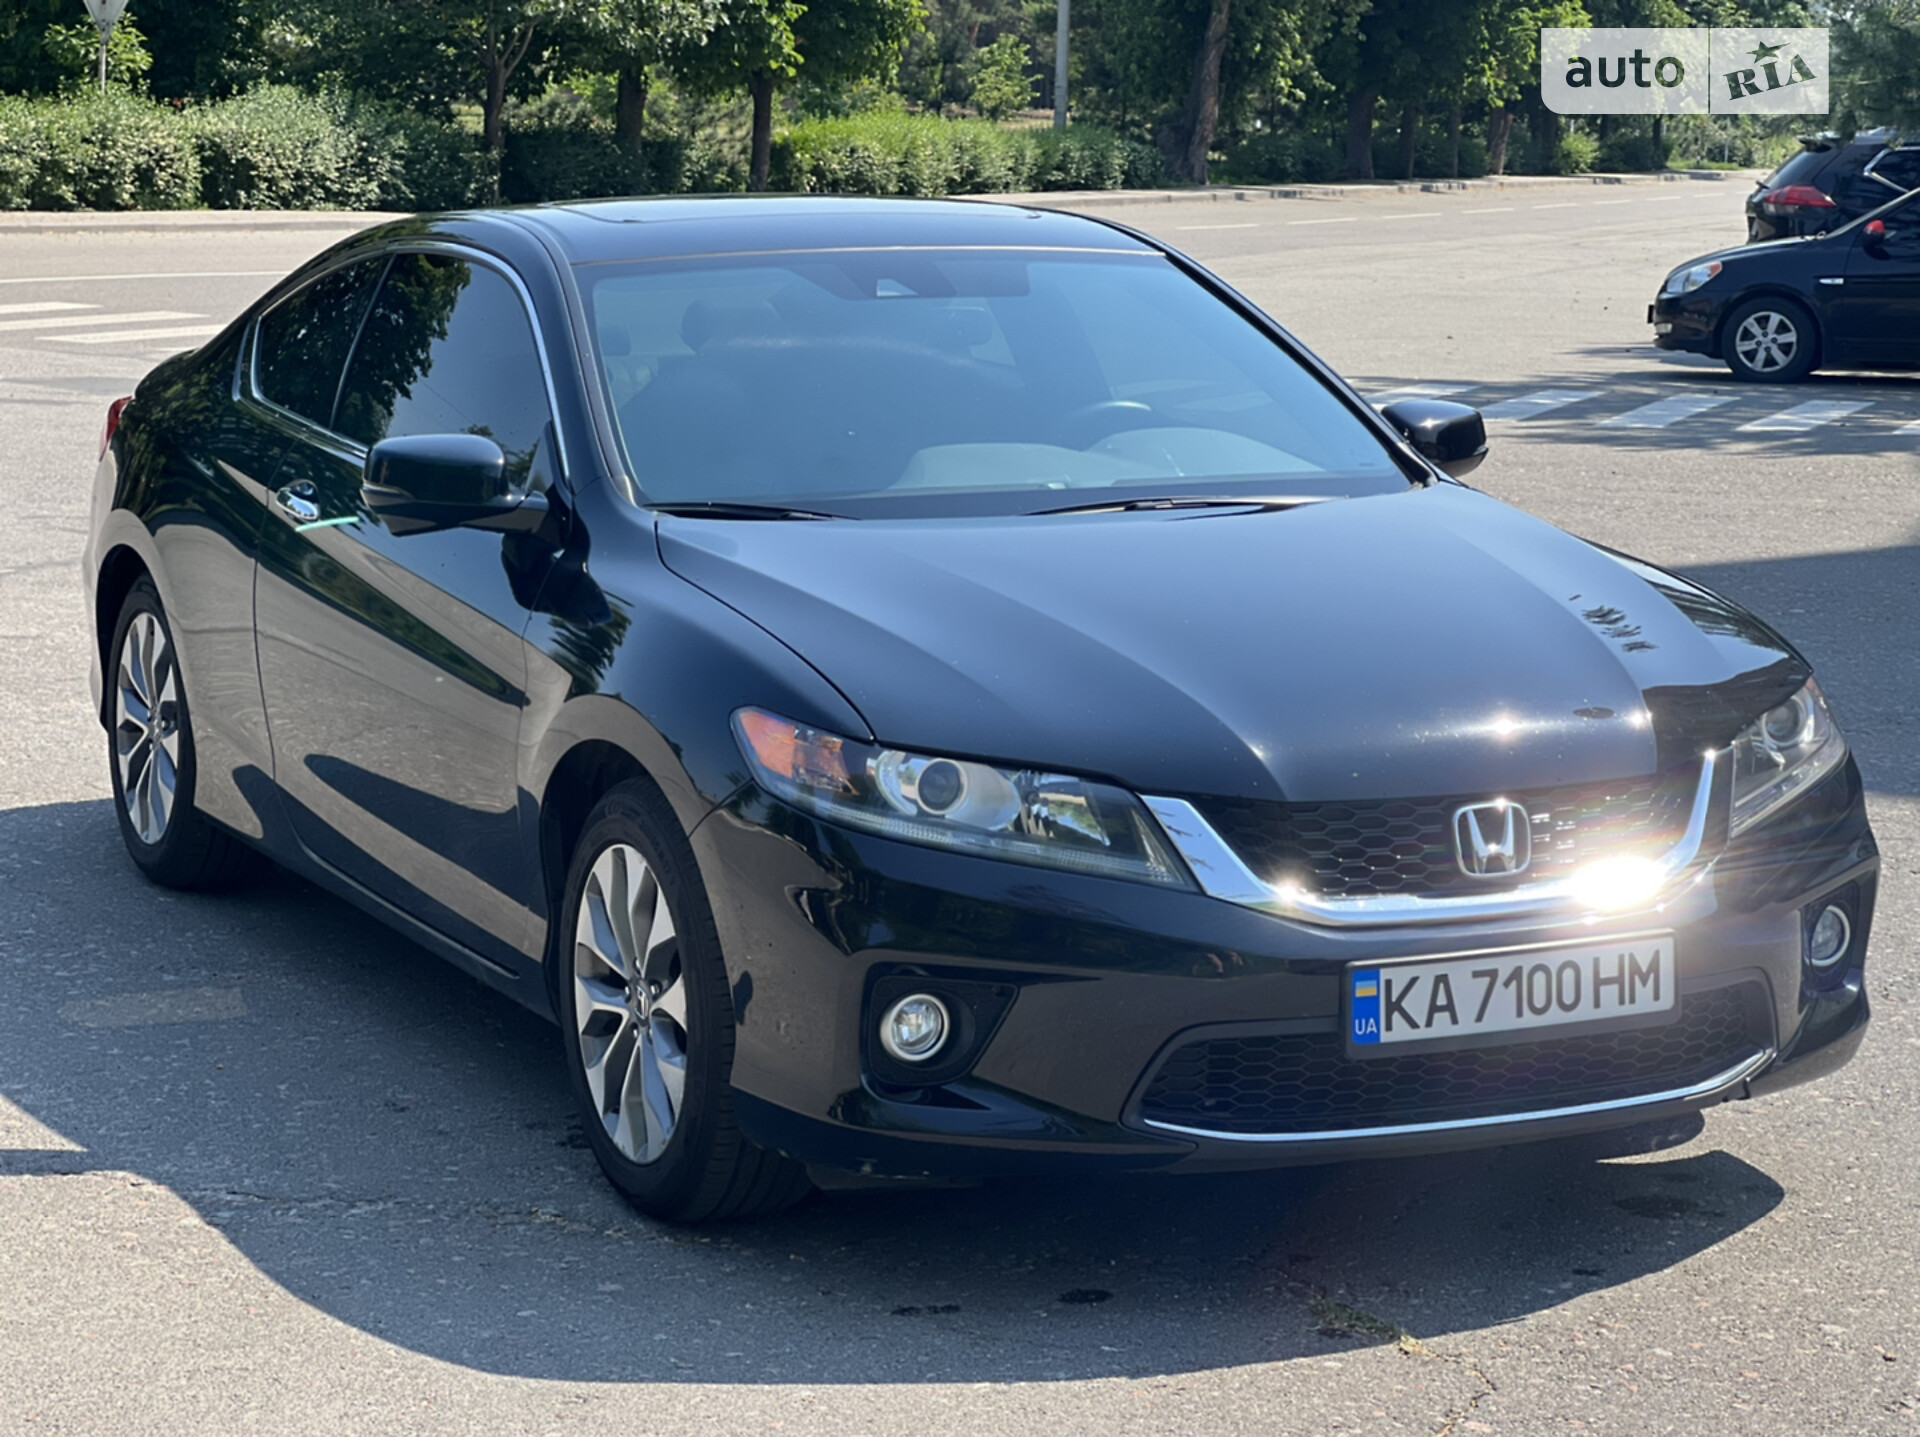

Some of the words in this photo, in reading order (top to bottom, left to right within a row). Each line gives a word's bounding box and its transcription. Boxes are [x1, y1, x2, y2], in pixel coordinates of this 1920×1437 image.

[1384, 973, 1459, 1032] KA
[1471, 959, 1581, 1023] 7100
[1592, 948, 1661, 1010] HM
[1354, 1017, 1378, 1035] UA
